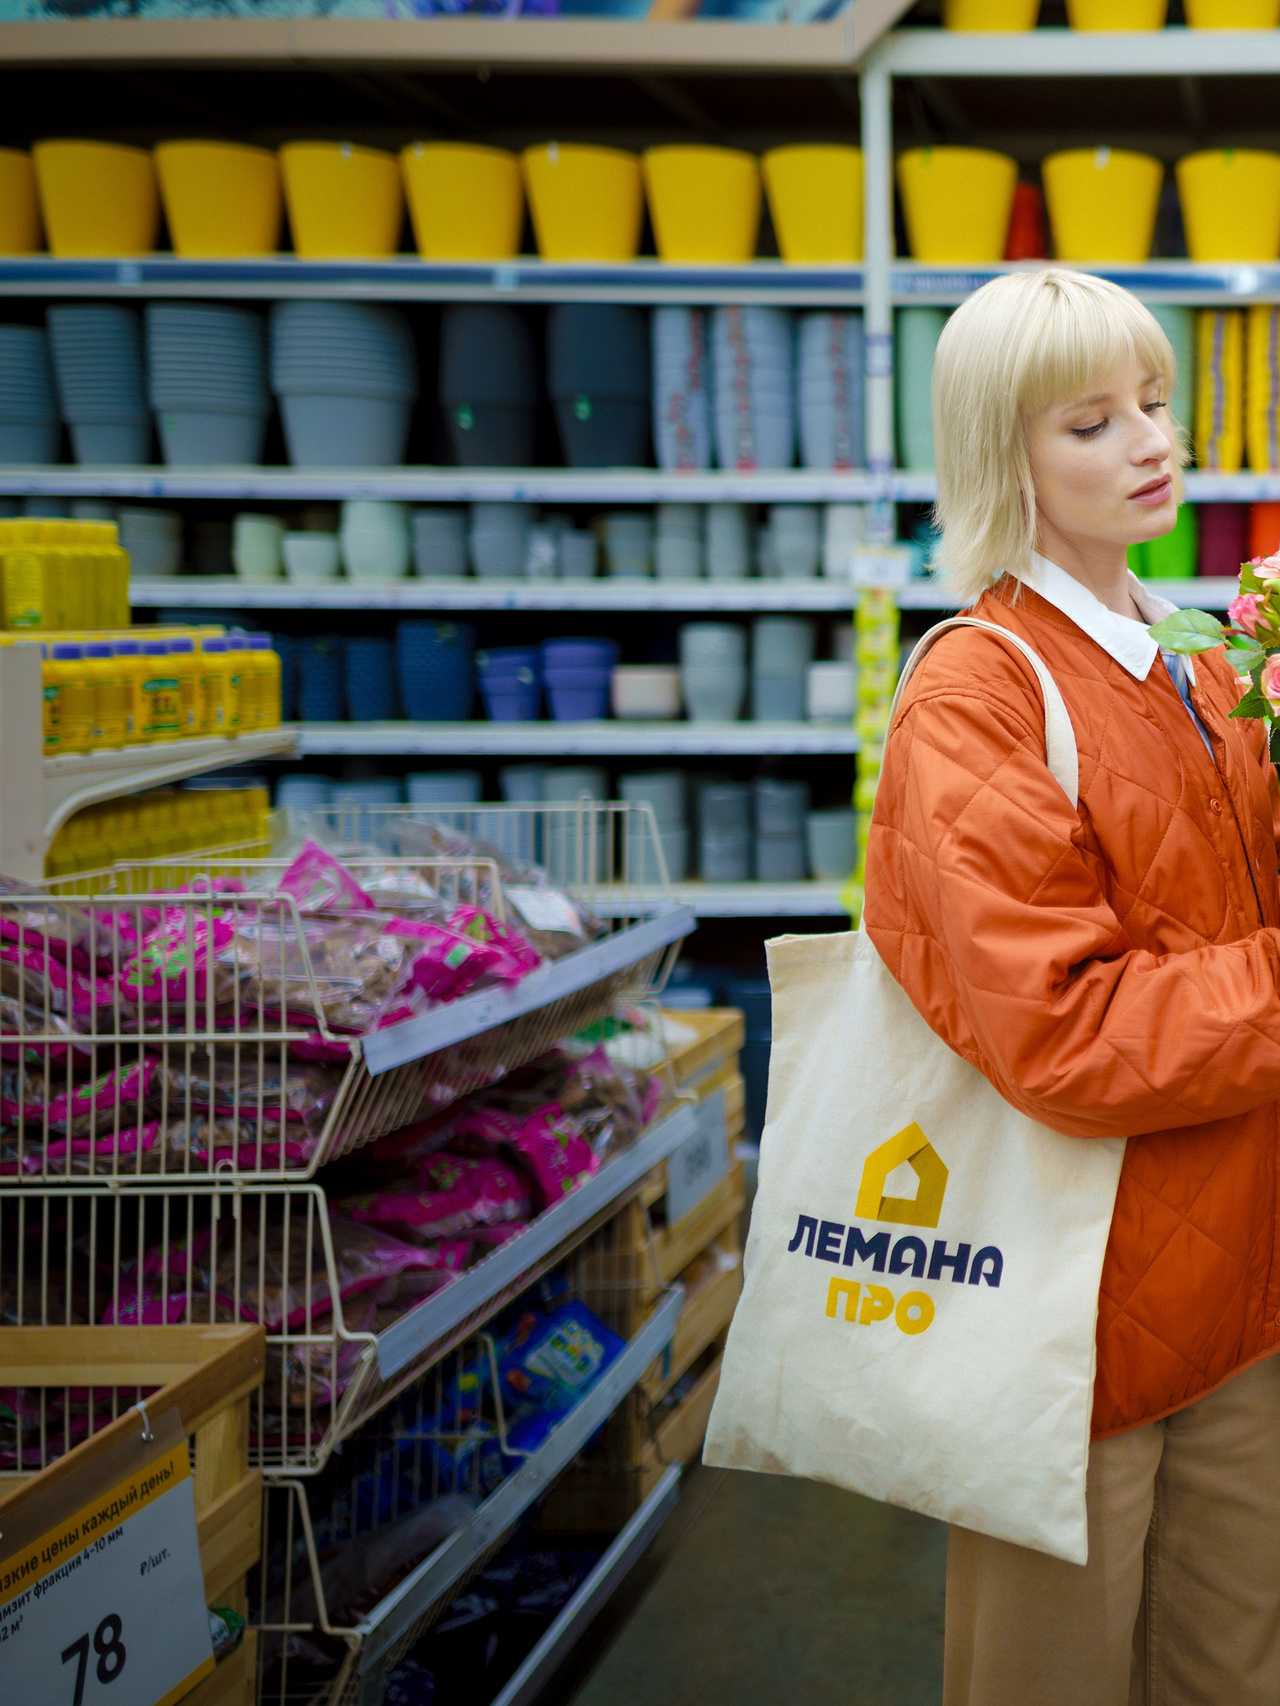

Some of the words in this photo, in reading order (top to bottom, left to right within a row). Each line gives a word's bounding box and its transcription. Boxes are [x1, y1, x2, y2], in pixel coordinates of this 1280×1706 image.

[787, 1214, 1004, 1288] ЛЕМАНА
[825, 1276, 936, 1336] ПРО
[41, 1526, 80, 1564] цены
[82, 1485, 138, 1538] каждый
[140, 1460, 175, 1500] день!
[33, 1556, 82, 1599] фракция
[83, 1535, 106, 1560] 4-10
[107, 1526, 124, 1545] мм
[61, 1613, 127, 1706] 78
